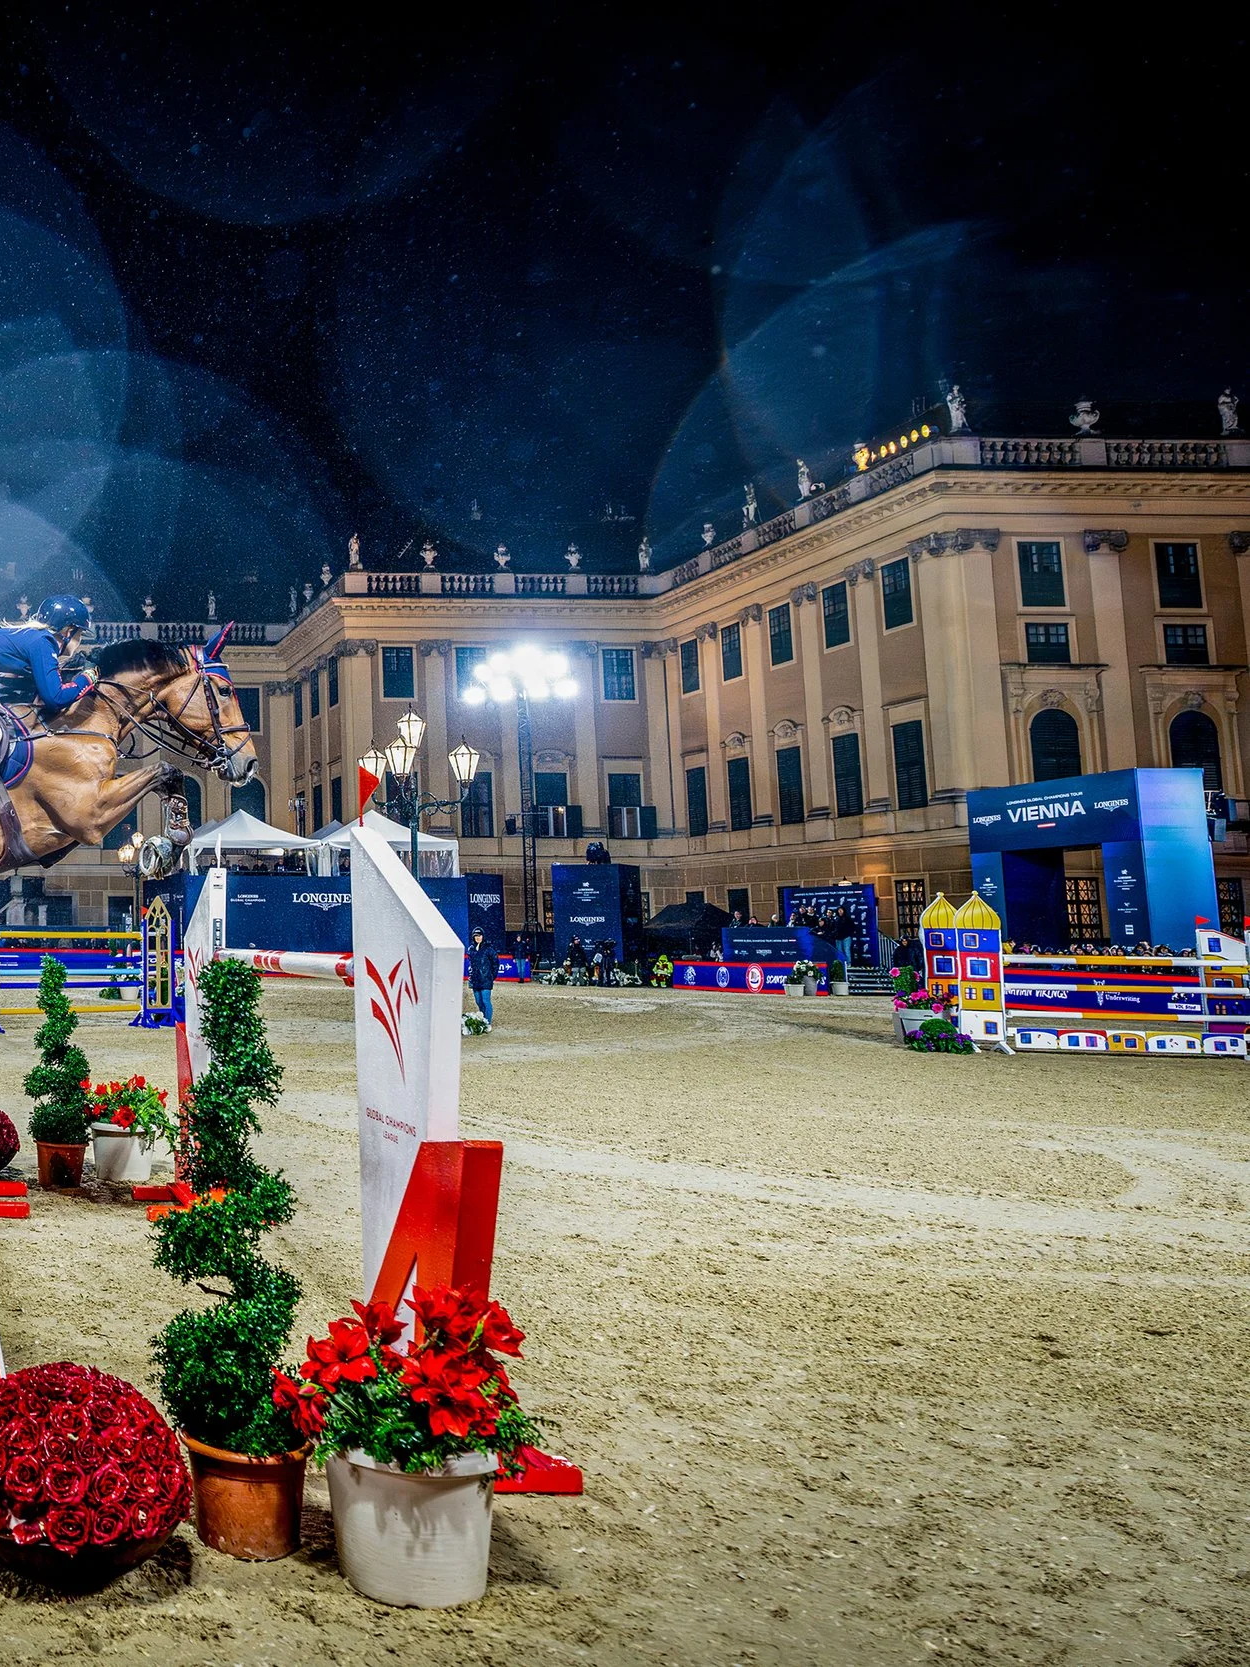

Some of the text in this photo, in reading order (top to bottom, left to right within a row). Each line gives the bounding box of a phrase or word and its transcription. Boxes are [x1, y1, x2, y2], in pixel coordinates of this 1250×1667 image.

[1094, 798, 1129, 810] LONGINES
[1007, 800, 1086, 823] VIENNA
[972, 814, 1002, 824] LONGINES
[292, 892, 352, 904] LONGINE
[469, 893, 501, 904] LONGINES
[1105, 994, 1141, 1004] Underwriting
[365, 1107, 417, 1137] GLOBAL CHAMPIONS
[382, 1130, 399, 1144] LEAGUE
